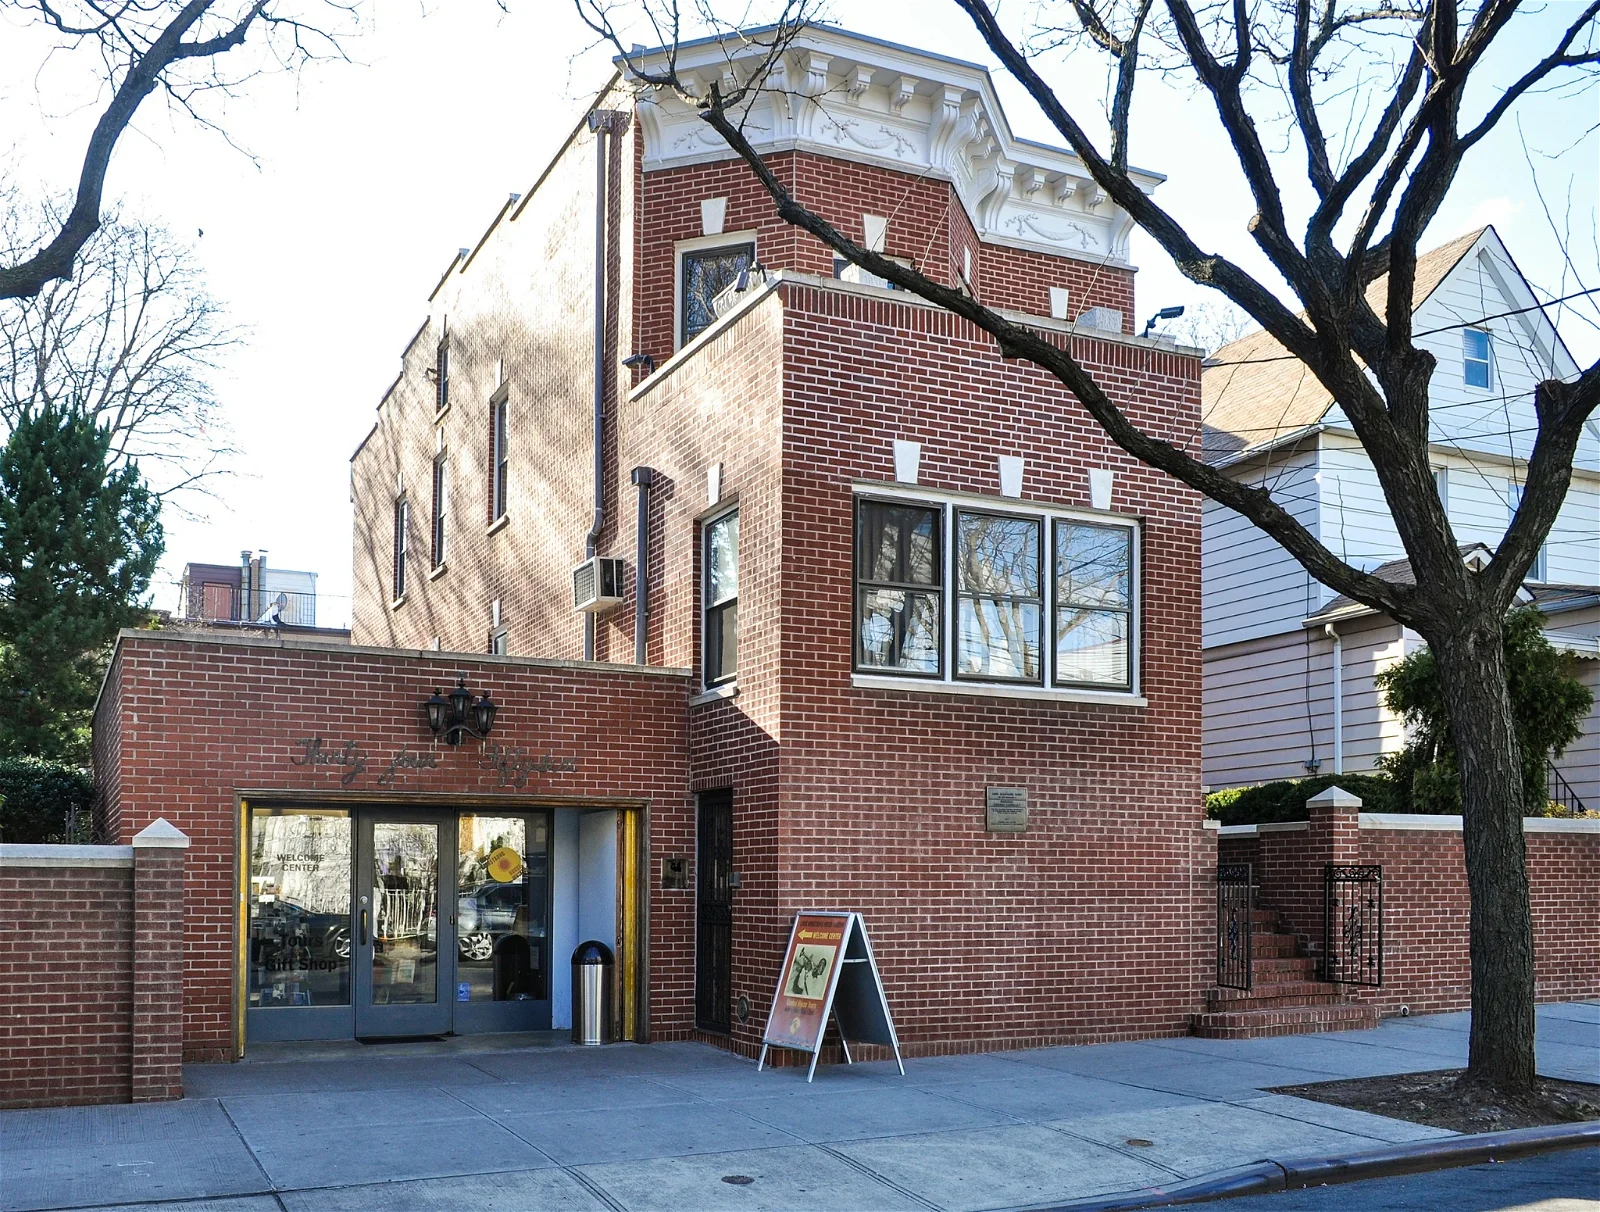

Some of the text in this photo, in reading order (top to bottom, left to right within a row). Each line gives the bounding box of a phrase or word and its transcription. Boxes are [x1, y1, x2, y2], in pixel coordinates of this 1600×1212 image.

[277, 853, 325, 862] WELCOME
[282, 864, 320, 872] CENTER
[280, 935, 323, 947] Tours
[265, 957, 337, 973] Gift Shop
